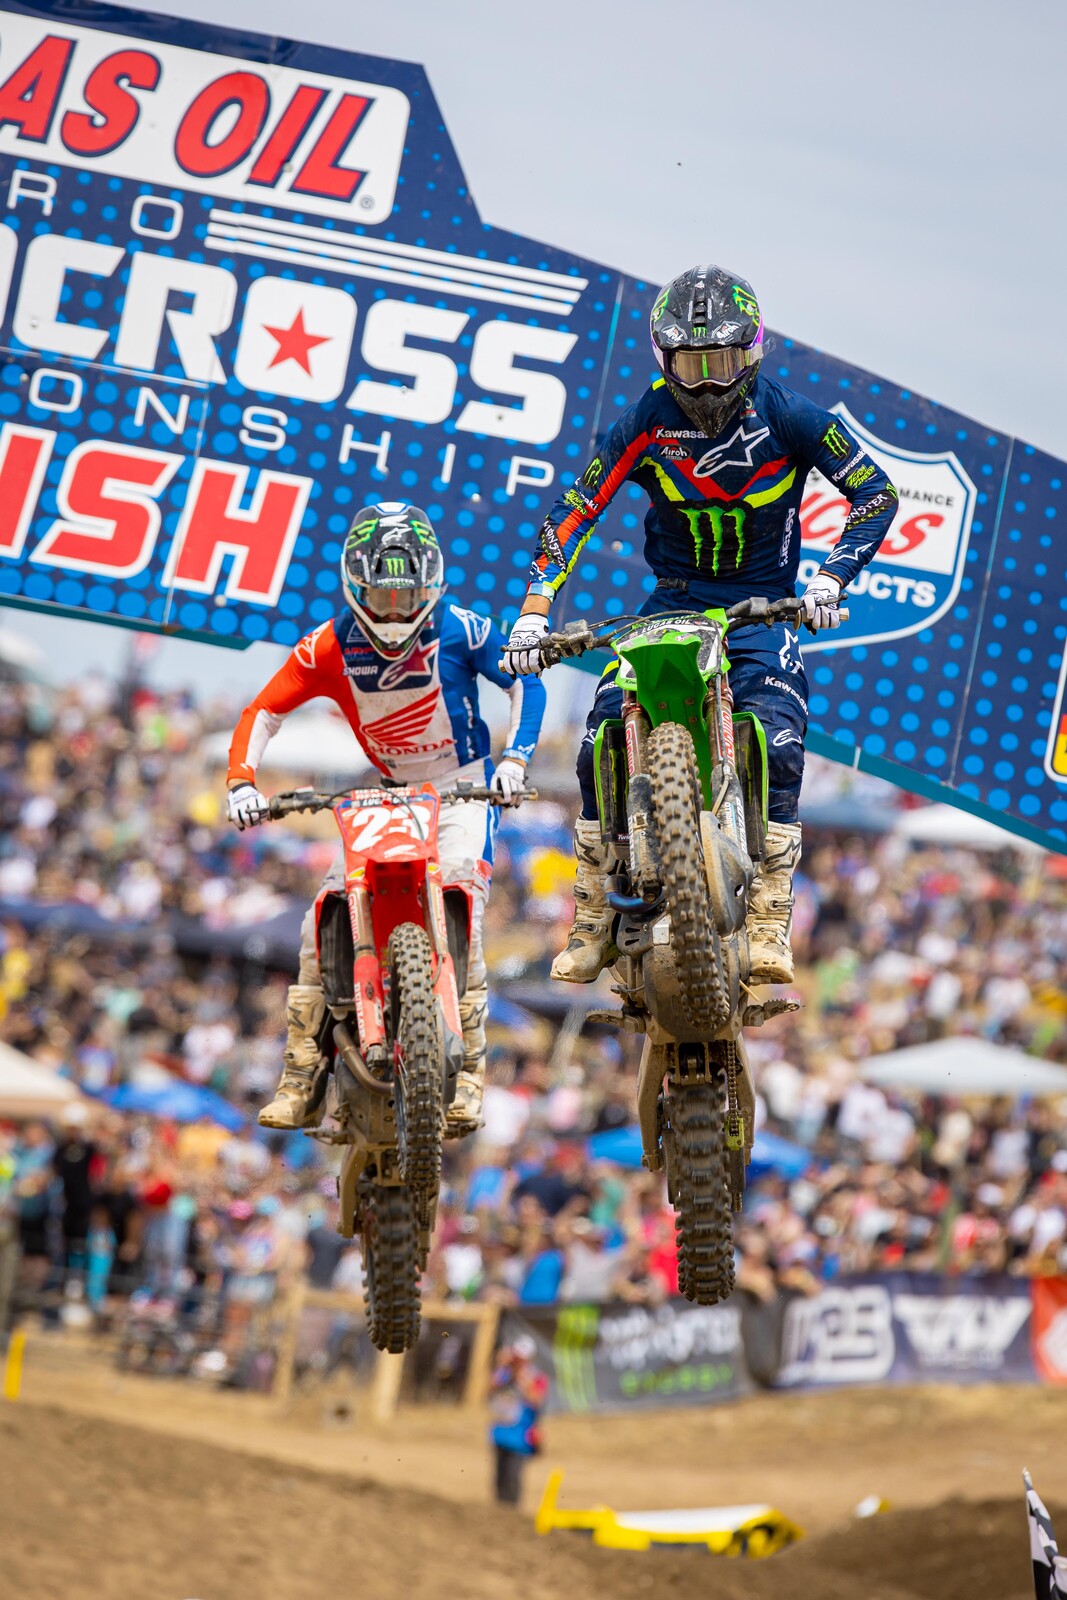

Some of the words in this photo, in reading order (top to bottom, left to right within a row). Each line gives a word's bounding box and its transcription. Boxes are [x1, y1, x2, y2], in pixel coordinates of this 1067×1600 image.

[174, 69, 377, 204] OIL
[0, 222, 579, 445] CROSS
[656, 428, 717, 439] Kawasa
[661, 446, 687, 457] Airoh
[797, 559, 937, 608] OUCTS
[342, 666, 379, 677] SHOWA
[370, 738, 458, 757] HONDA
[351, 804, 431, 853] 23
[353, 981, 367, 1043] DUNLOP
